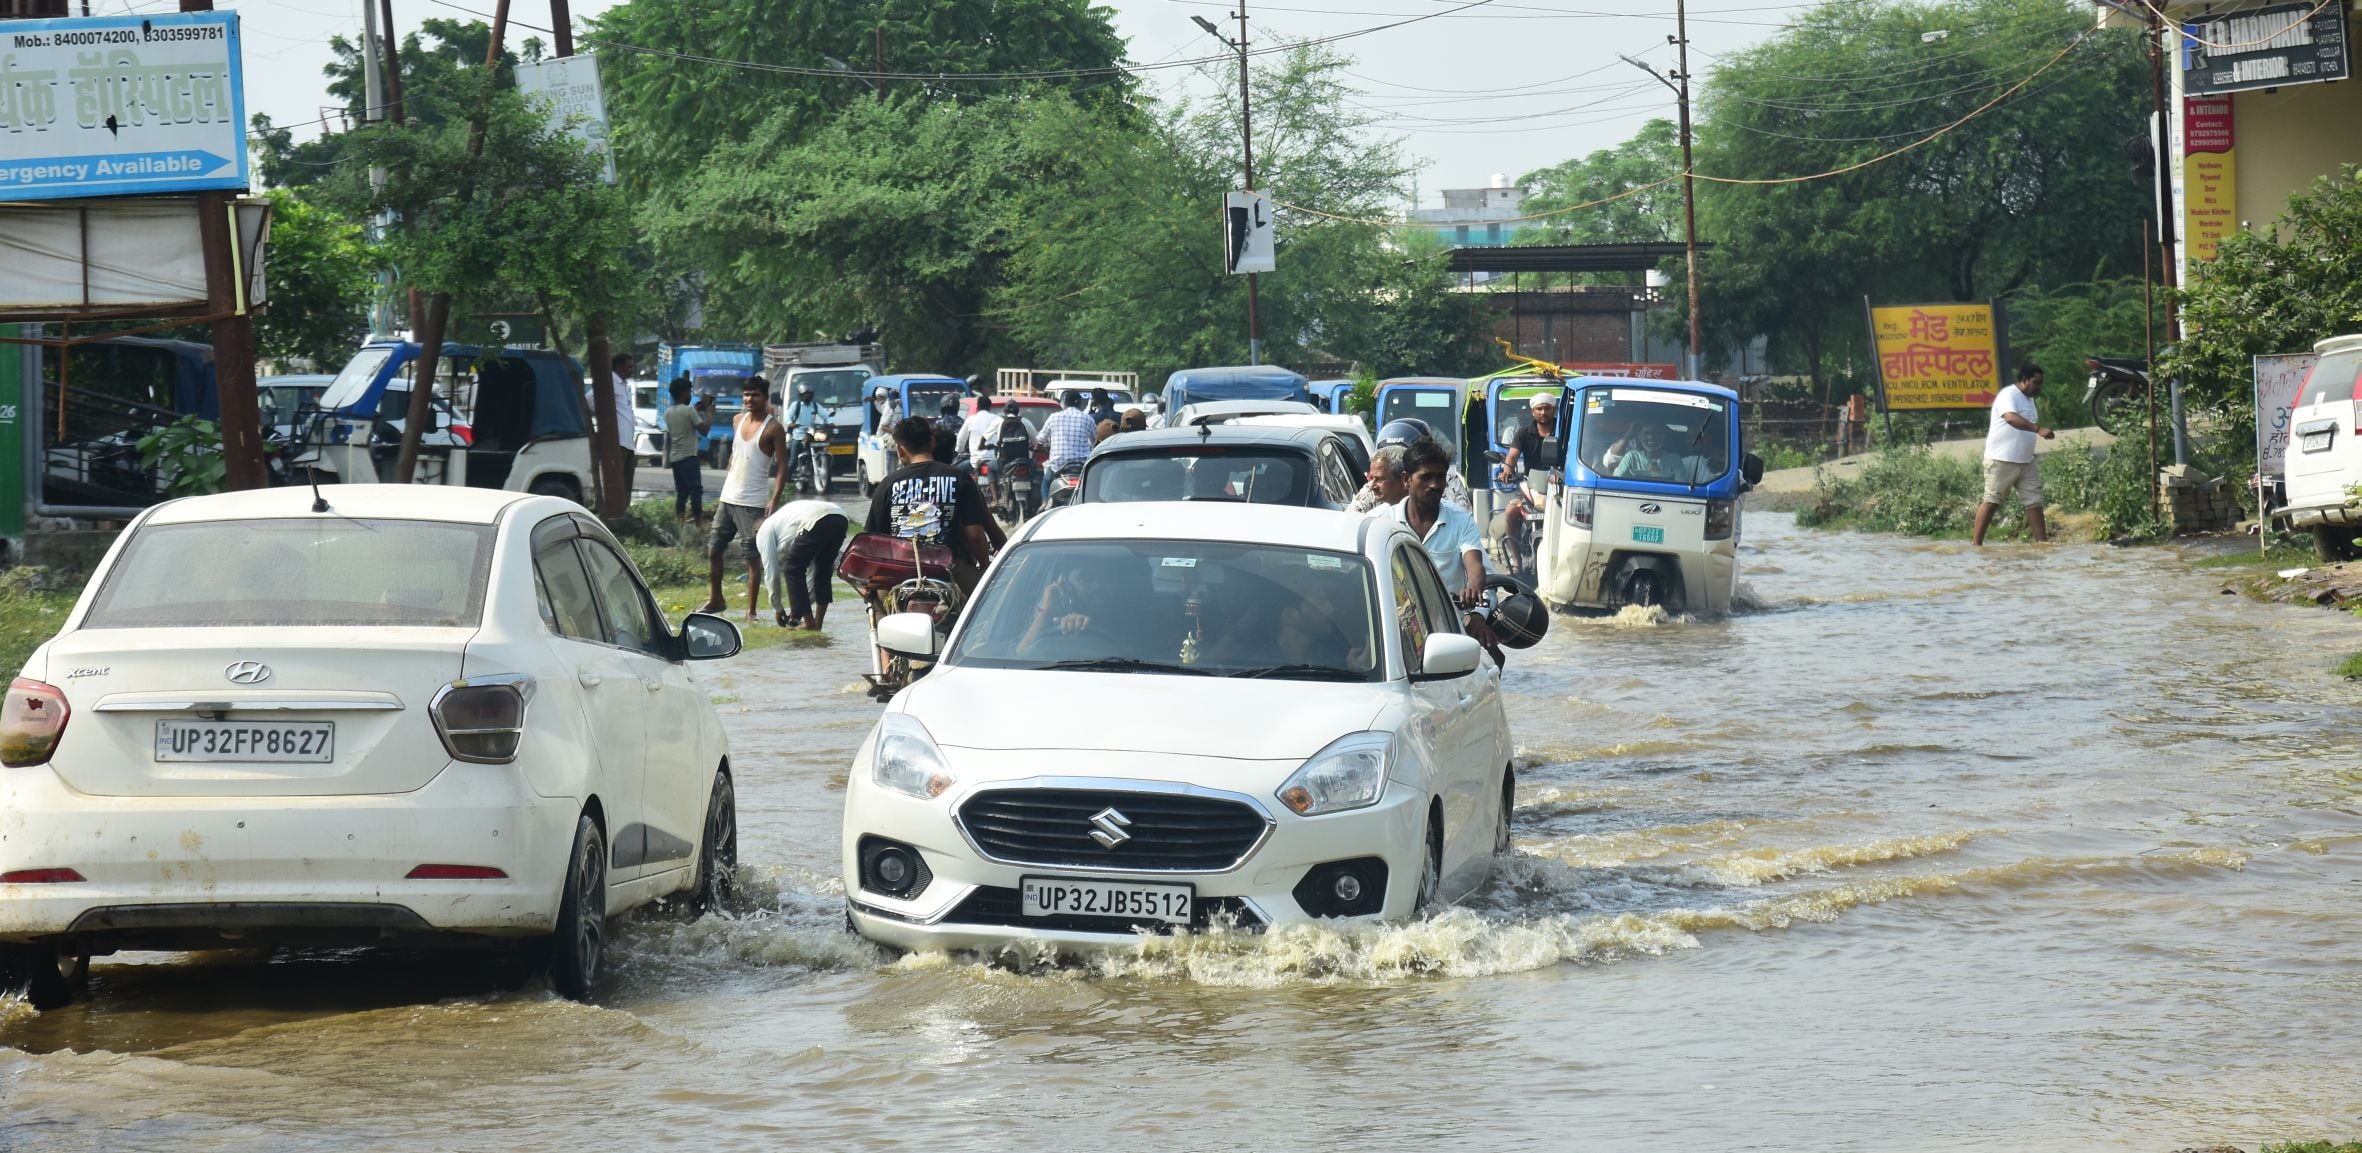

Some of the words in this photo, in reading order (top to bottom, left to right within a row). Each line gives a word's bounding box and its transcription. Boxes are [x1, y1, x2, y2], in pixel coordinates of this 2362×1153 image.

[14, 35, 50, 48] Mob.:
[54, 30, 140, 46] 8400074200,
[2230, 9, 2314, 55] HARDWARE
[2233, 61, 2241, 82] &
[570, 83, 594, 95] SUN
[96, 156, 202, 176] Available
[1908, 308, 1949, 342] मेड
[1942, 379, 1990, 389] VENTILATOR
[0, 405, 16, 418] 26
[172, 728, 330, 755] UP32FP8627
[1039, 886, 1188, 917] UP32JB5512
